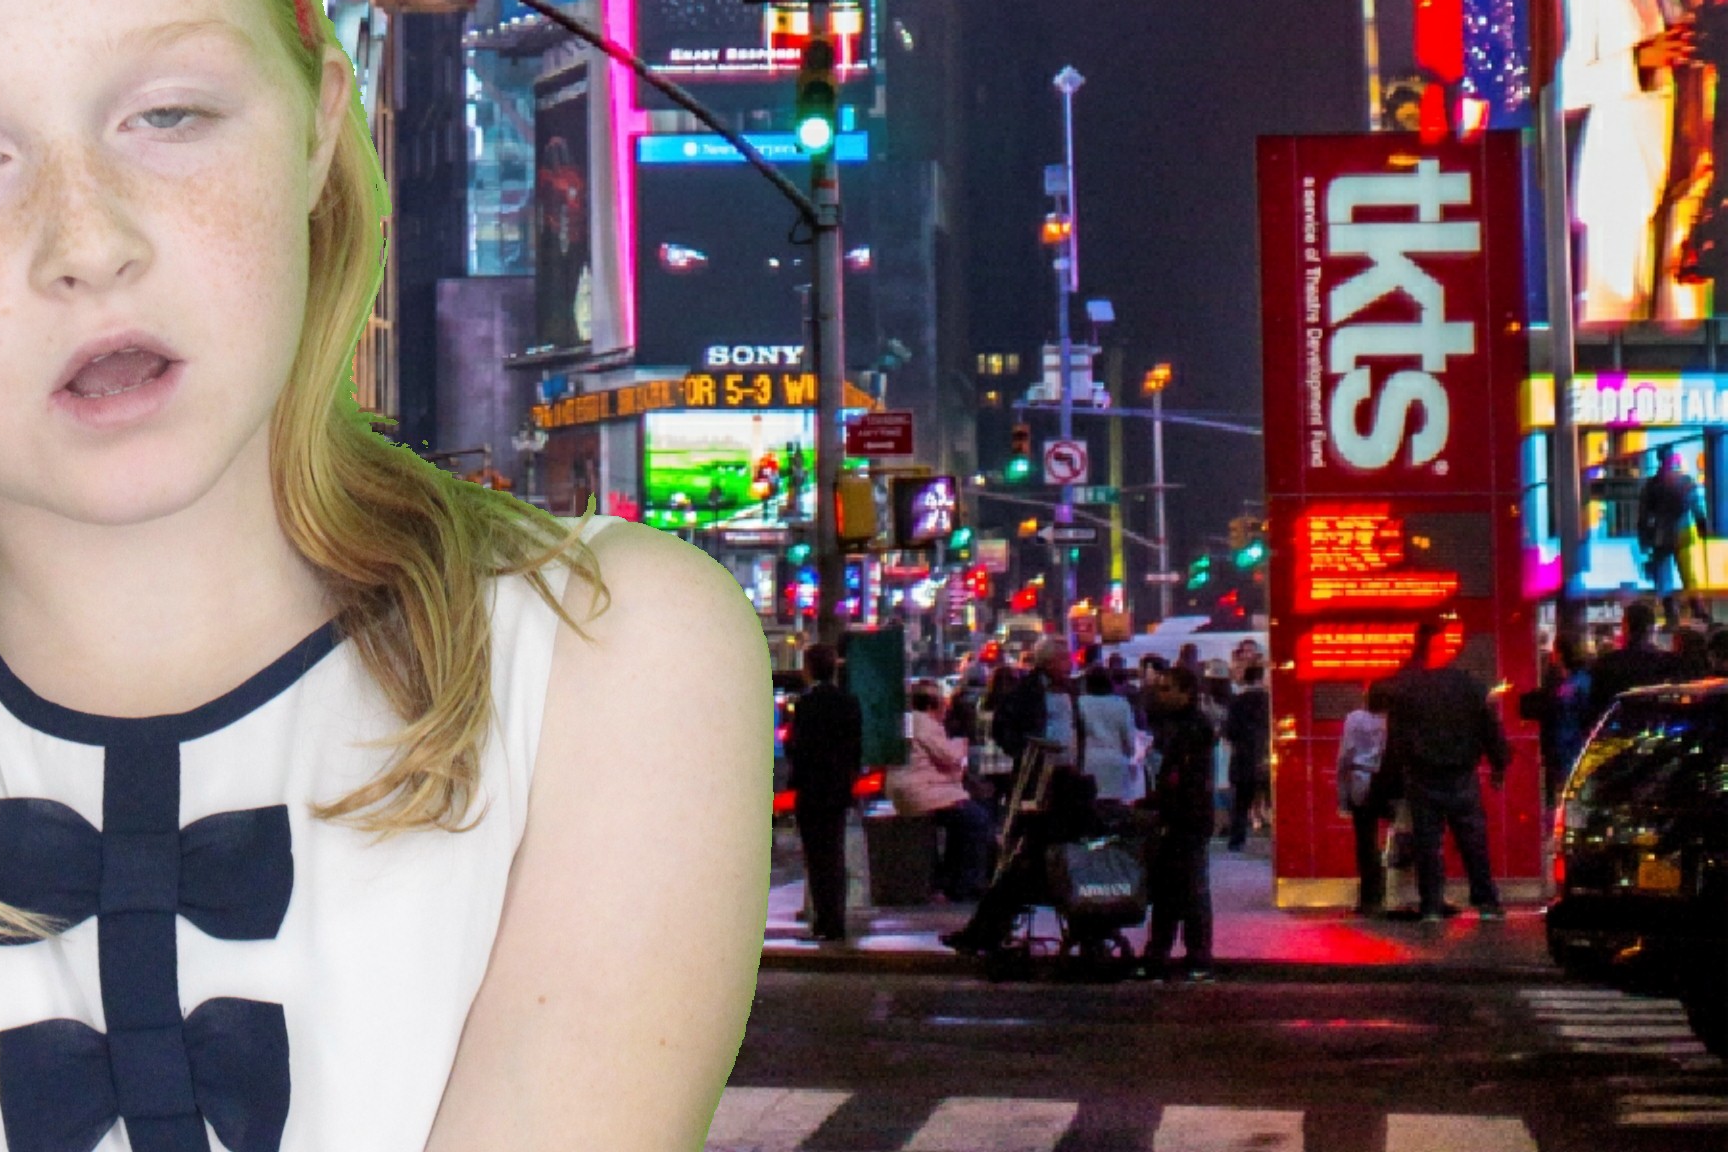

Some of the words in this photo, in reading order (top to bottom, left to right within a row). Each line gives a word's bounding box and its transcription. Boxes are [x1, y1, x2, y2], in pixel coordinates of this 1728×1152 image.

[1302, 189, 1321, 244] service
[1304, 247, 1322, 263] of
[1325, 158, 1481, 470] tkts
[707, 345, 804, 365] SONY
[725, 374, 771, 406] 5-3
[783, 373, 818, 406] WI
[1305, 327, 1324, 426] Development
[1309, 430, 1328, 468] Fund
